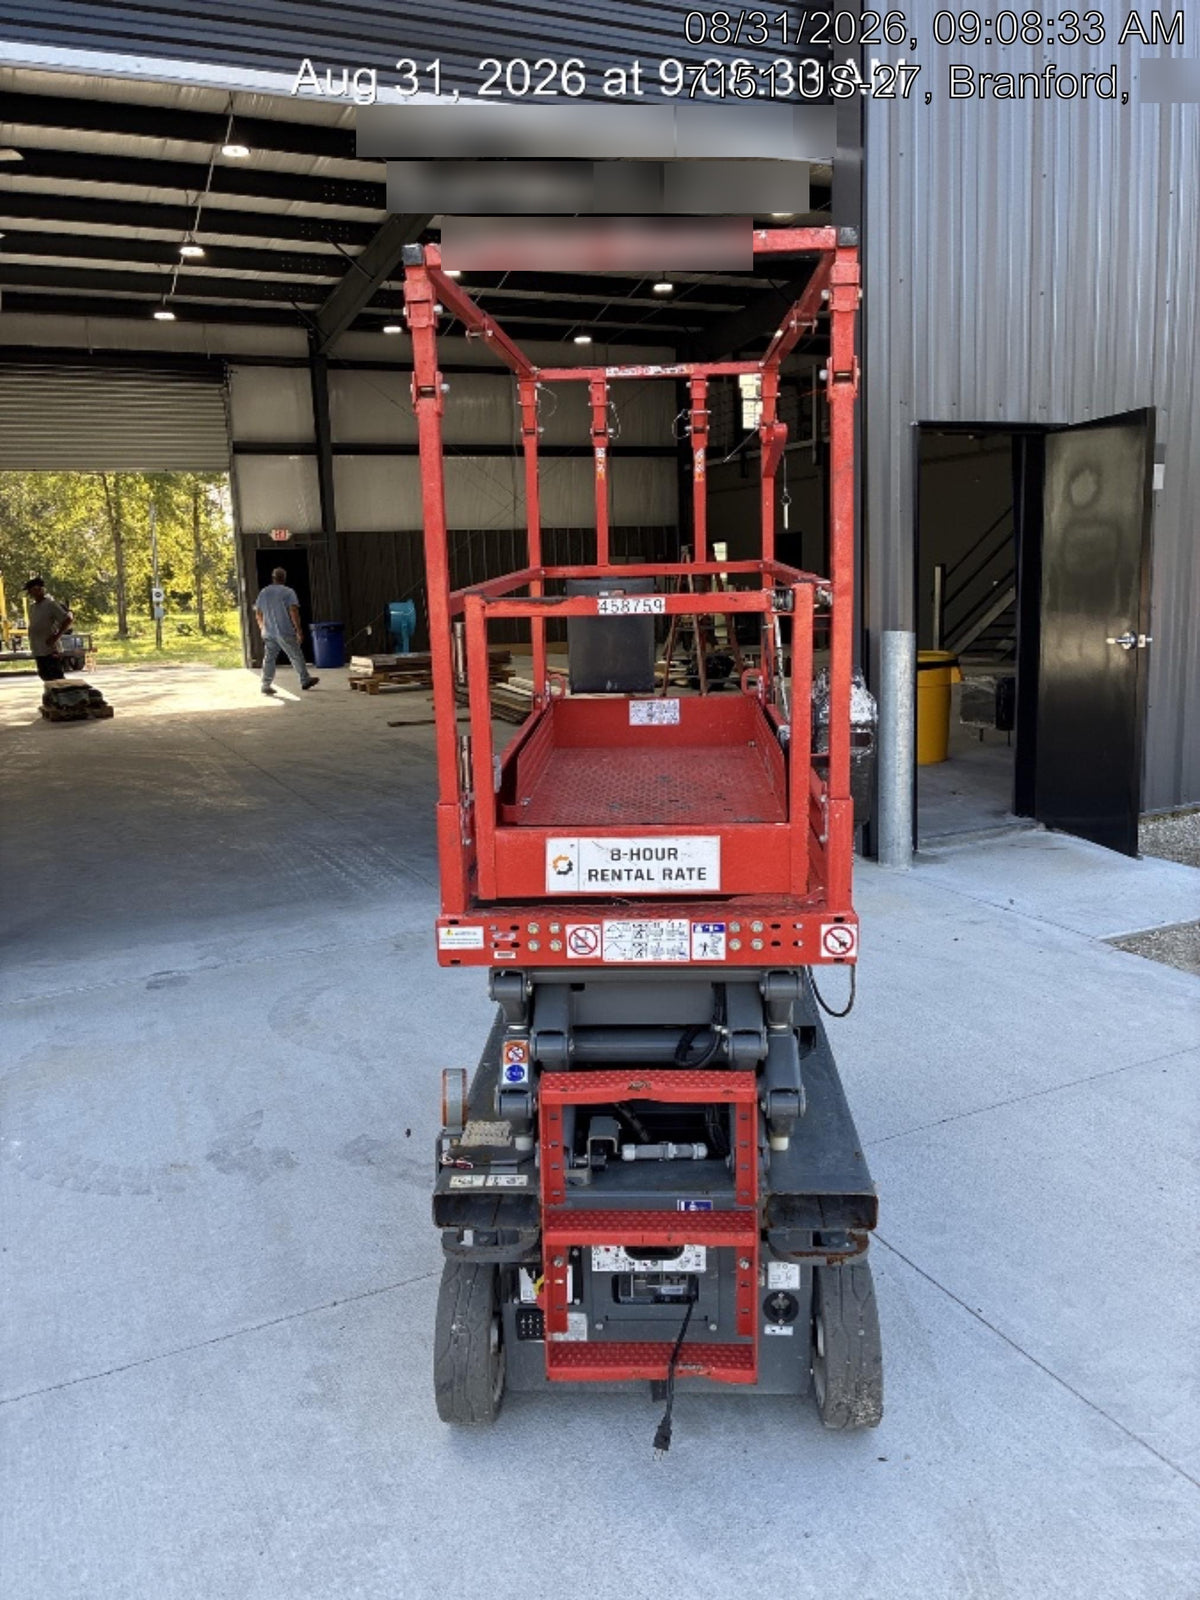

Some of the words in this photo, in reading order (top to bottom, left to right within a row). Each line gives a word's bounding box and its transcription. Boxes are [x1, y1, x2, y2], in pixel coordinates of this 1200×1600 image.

[600, 598, 662, 614] 458759
[611, 847, 679, 862] 8-HOUR
[587, 868, 655, 882] RENTAL
[662, 867, 707, 881] RATE
